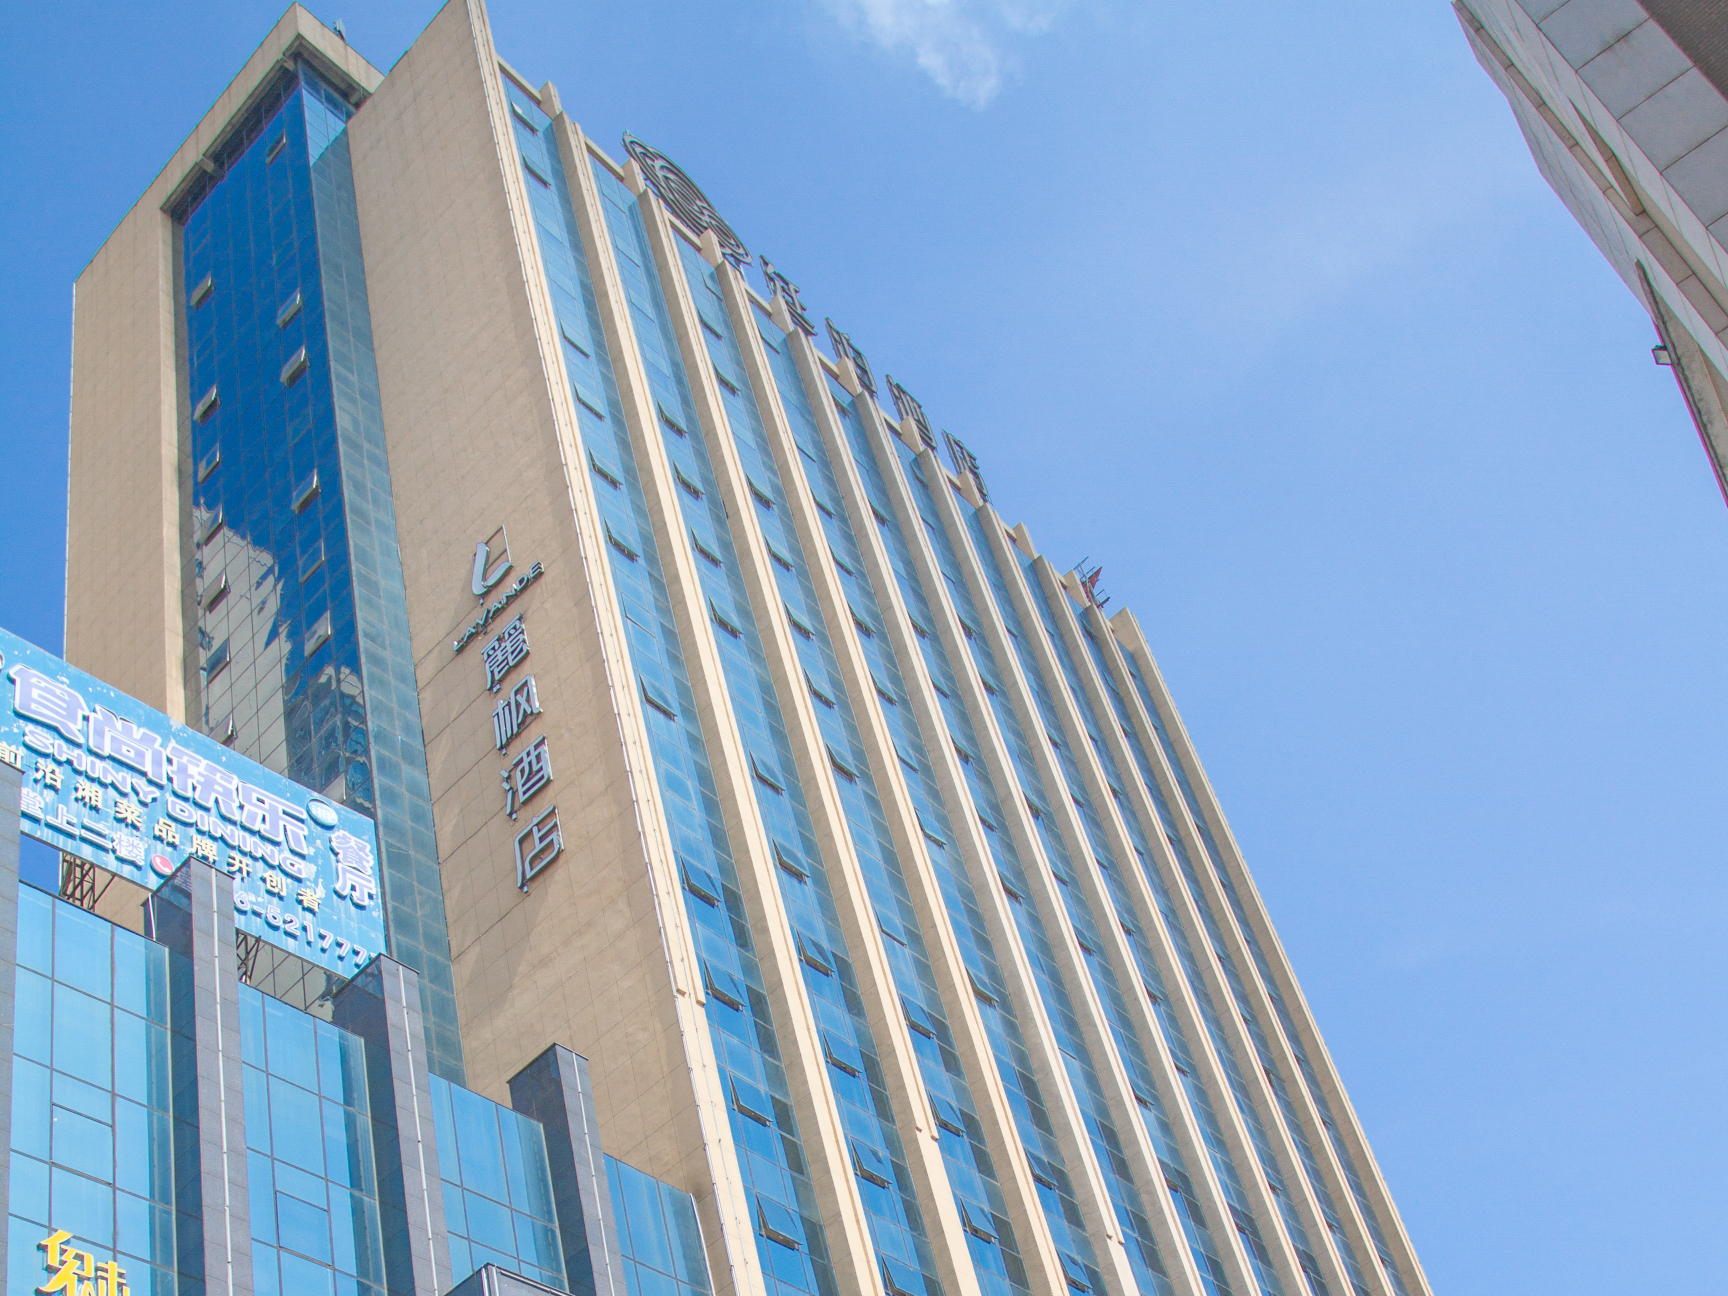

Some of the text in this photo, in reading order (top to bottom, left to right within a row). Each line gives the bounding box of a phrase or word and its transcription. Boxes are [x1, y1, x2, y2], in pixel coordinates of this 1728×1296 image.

[452, 560, 545, 654] LAVANDE
[8, 664, 308, 856] 食尚筷乐
[23, 727, 308, 879] SHINY DINING
[329, 829, 376, 906] 餐厅
